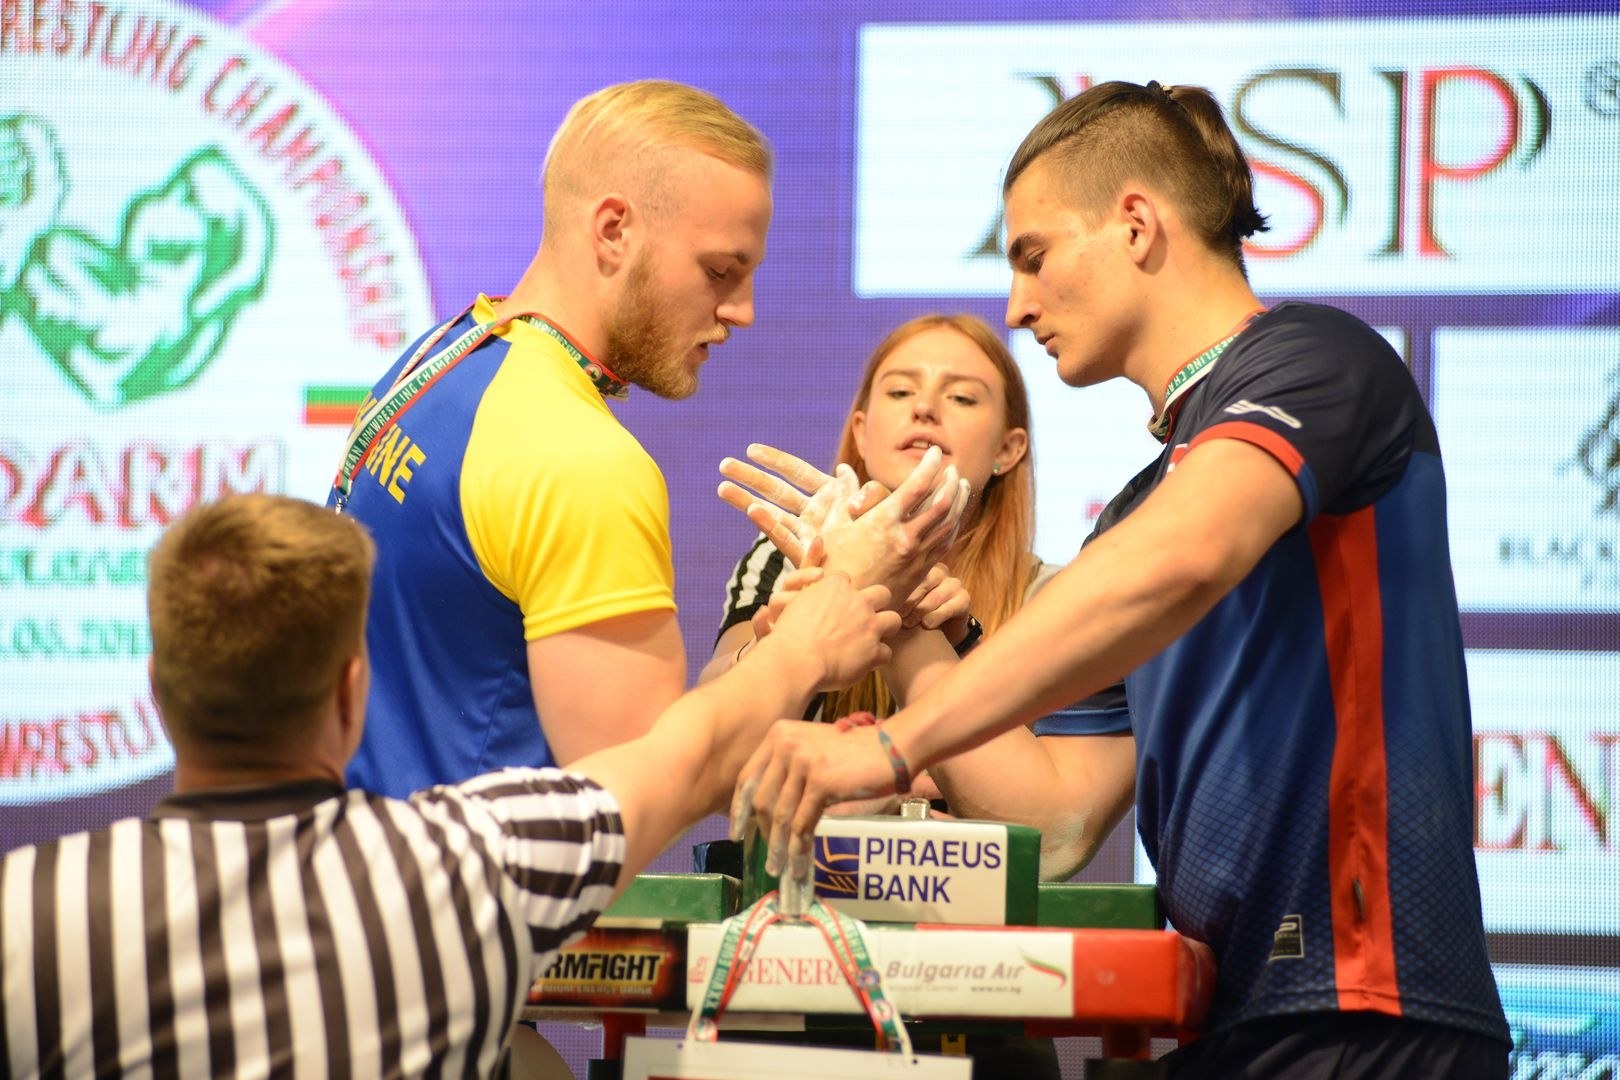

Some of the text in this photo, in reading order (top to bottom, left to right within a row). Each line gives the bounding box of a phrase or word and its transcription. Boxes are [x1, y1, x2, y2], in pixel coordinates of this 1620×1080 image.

[357, 386, 419, 448] ARMWRESTLING
[417, 324, 489, 386] CHAMPIONSHIP
[866, 838, 1001, 869] PIRAEUS
[865, 874, 952, 903] BANK
[886, 961, 1025, 983] Bulgaria Air
